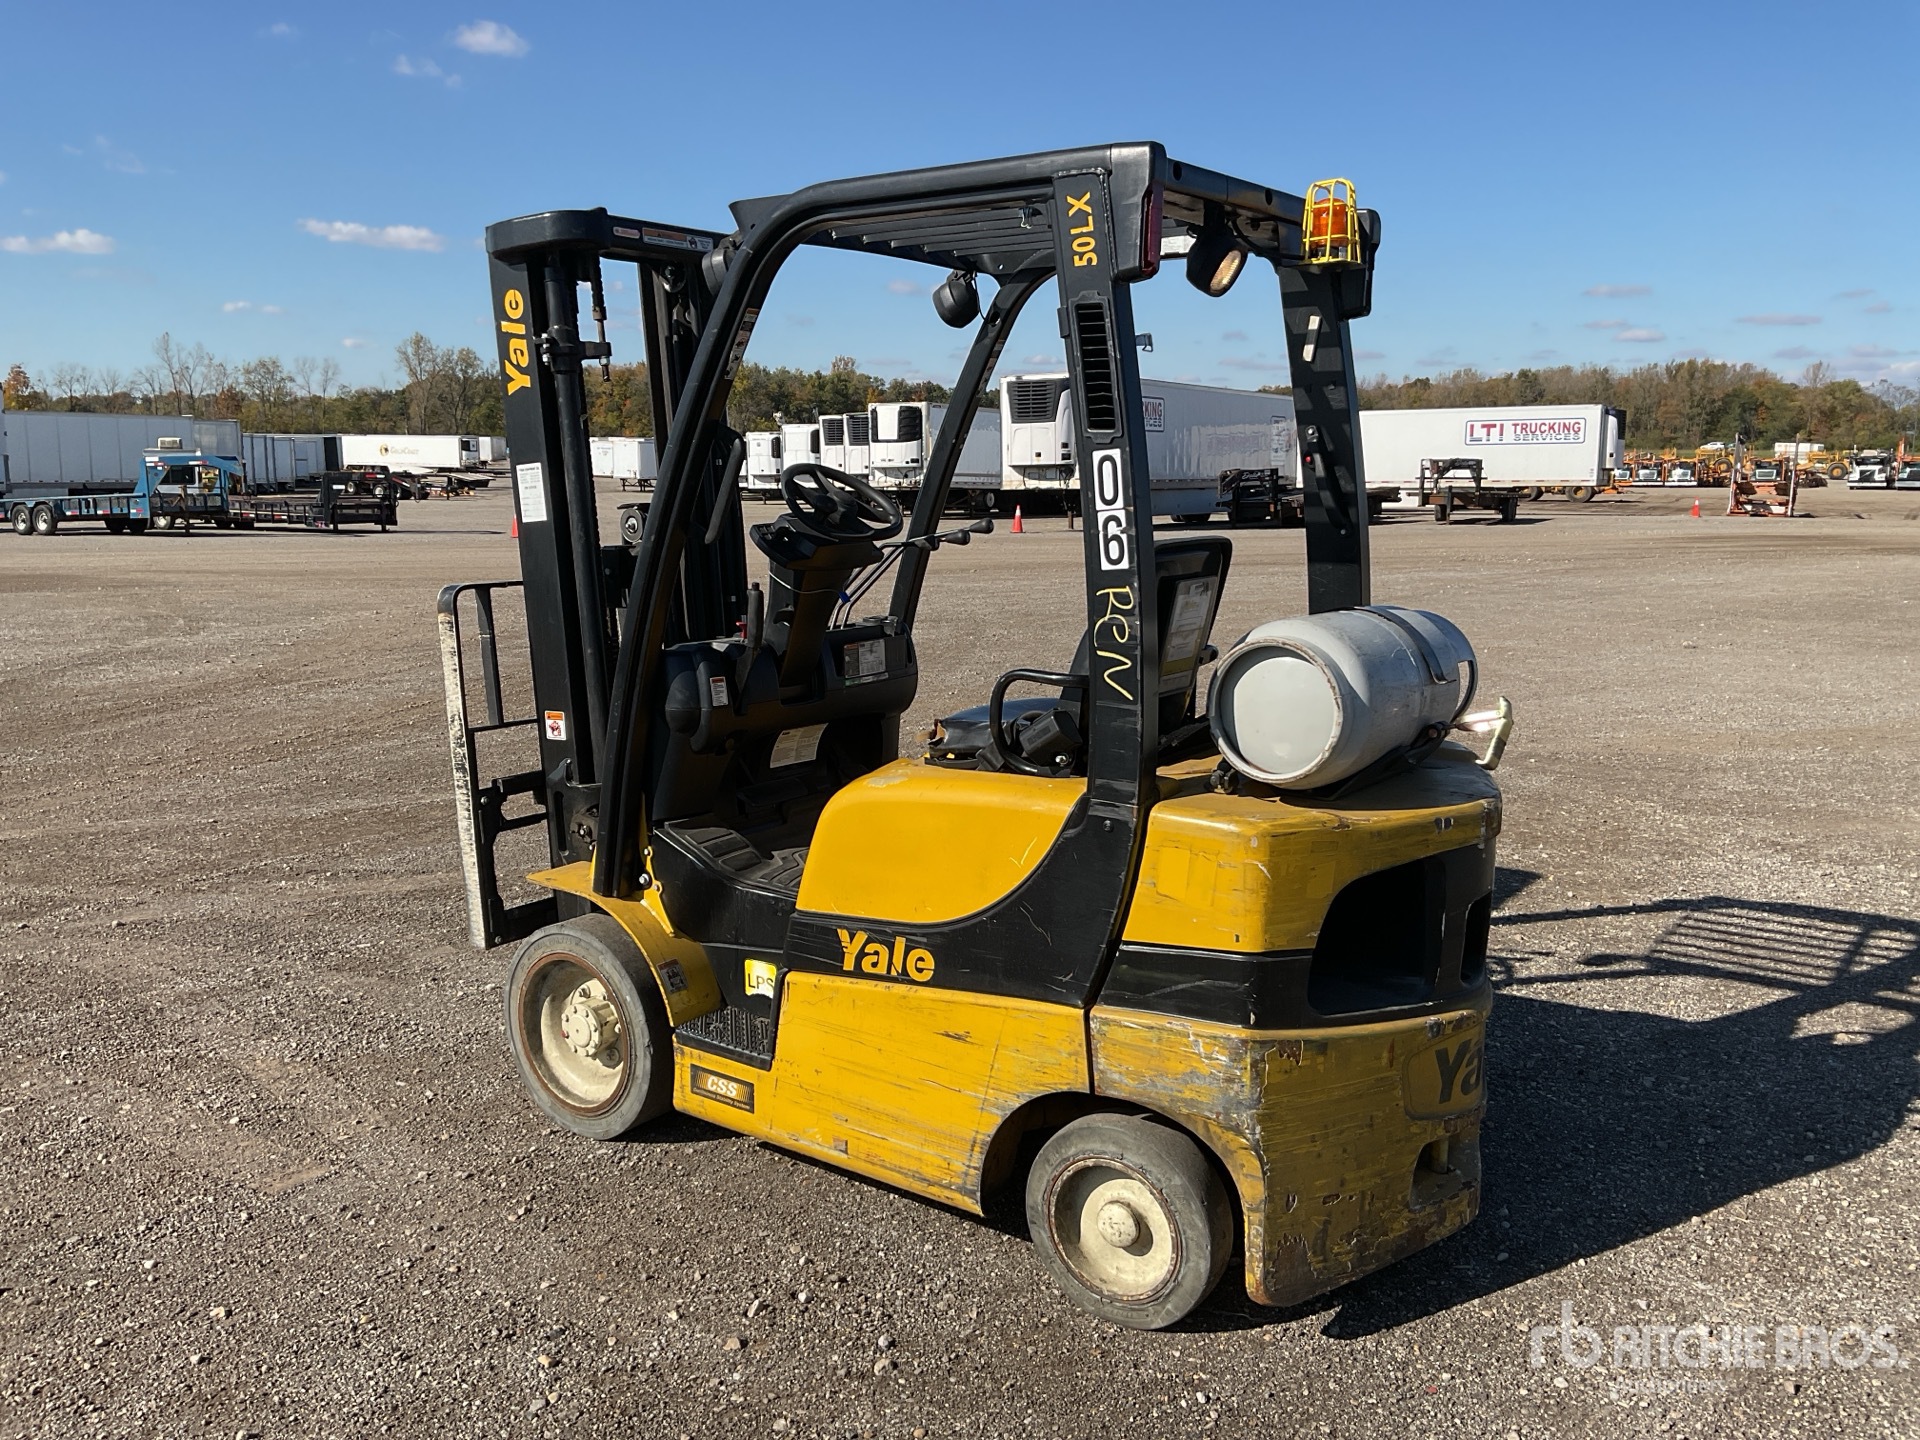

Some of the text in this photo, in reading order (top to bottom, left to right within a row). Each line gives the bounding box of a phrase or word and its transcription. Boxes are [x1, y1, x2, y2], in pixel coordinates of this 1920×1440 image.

[1066, 191, 1098, 267] 50LX
[501, 289, 531, 396] Yale
[1142, 401, 1163, 418] KING
[1469, 421, 1582, 442] LTI TRUCKING
[1513, 432, 1581, 442] SERVICES
[837, 928, 935, 982] Yale
[747, 973, 774, 990] LPS
[1435, 1037, 1483, 1105] Ya
[707, 1075, 737, 1097] CSS
